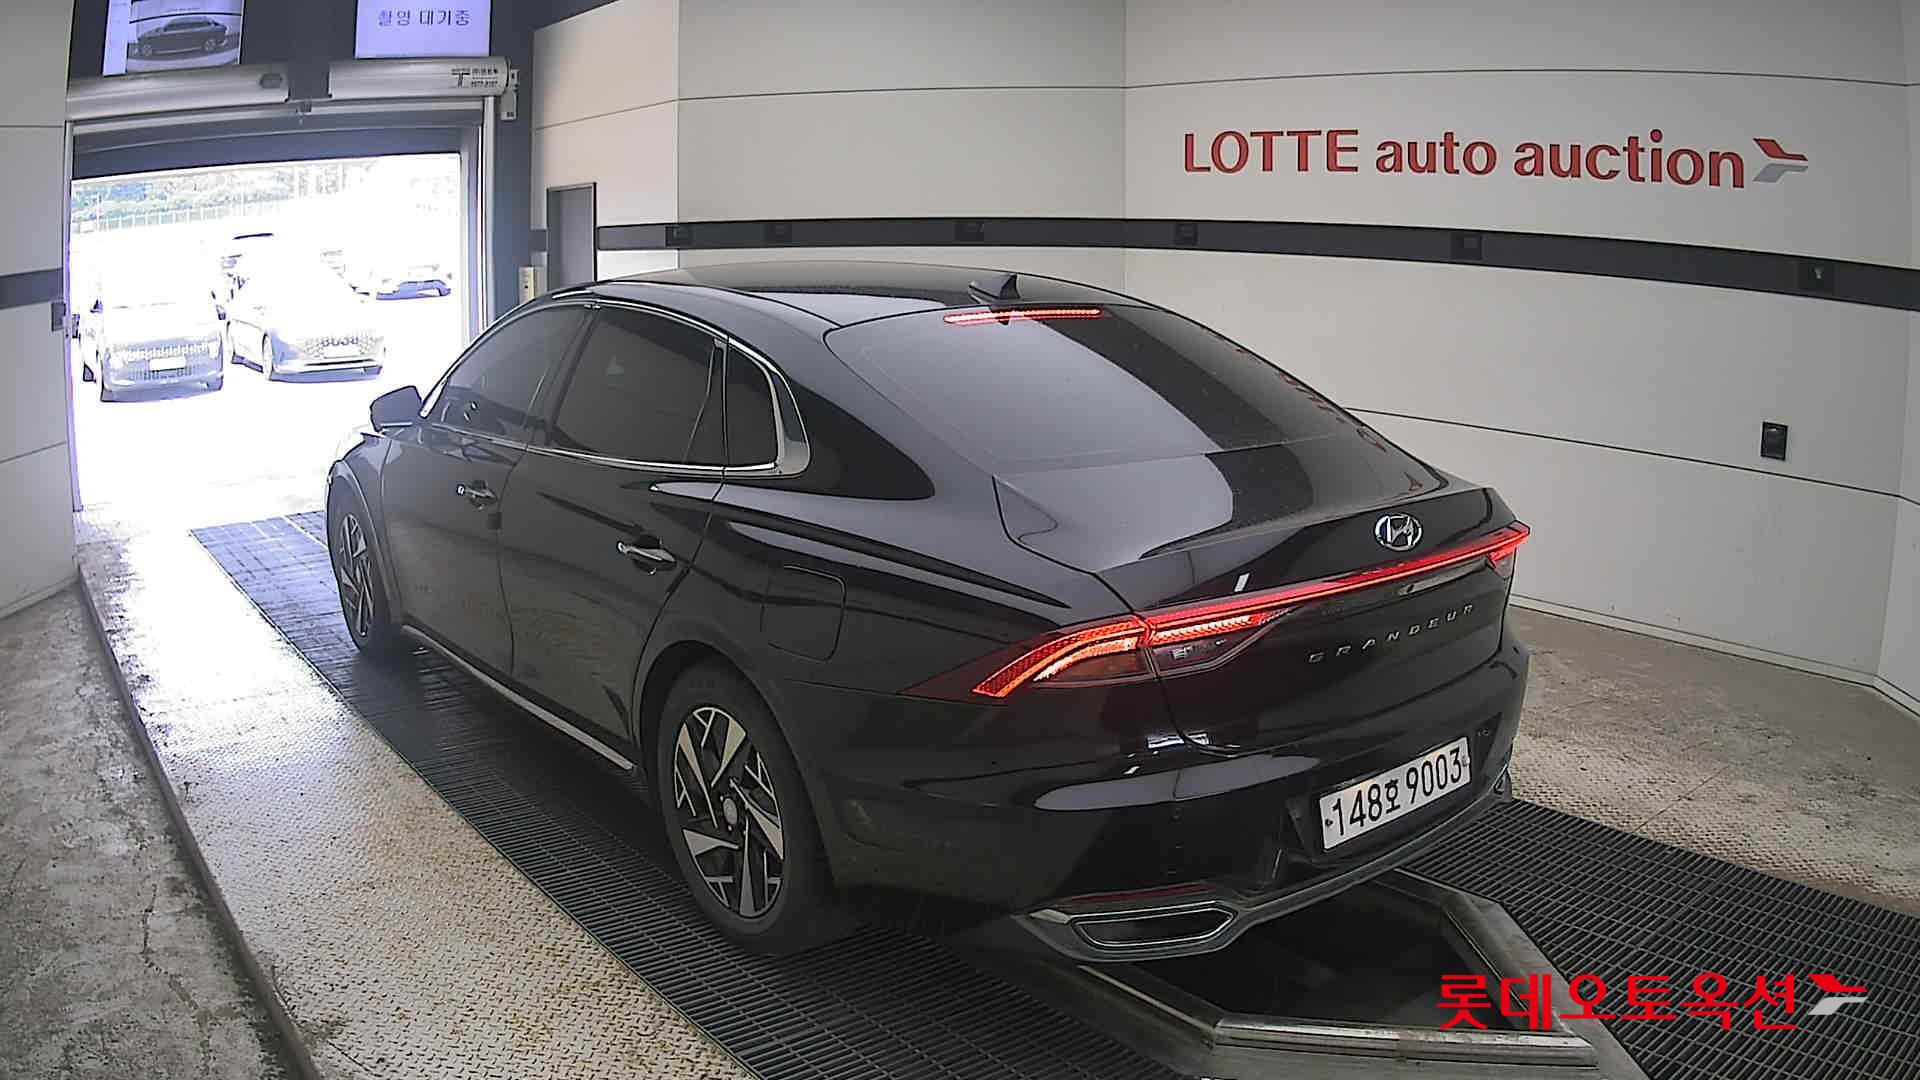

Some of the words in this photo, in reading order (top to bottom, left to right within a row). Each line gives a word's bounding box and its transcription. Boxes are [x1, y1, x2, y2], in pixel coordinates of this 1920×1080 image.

[419, 9, 470, 27] 대기중
[1184, 129, 1360, 174] LOTTE
[1376, 131, 1498, 176] auto
[1513, 128, 1745, 189] auction
[1308, 603, 1474, 664] GRANDEUR
